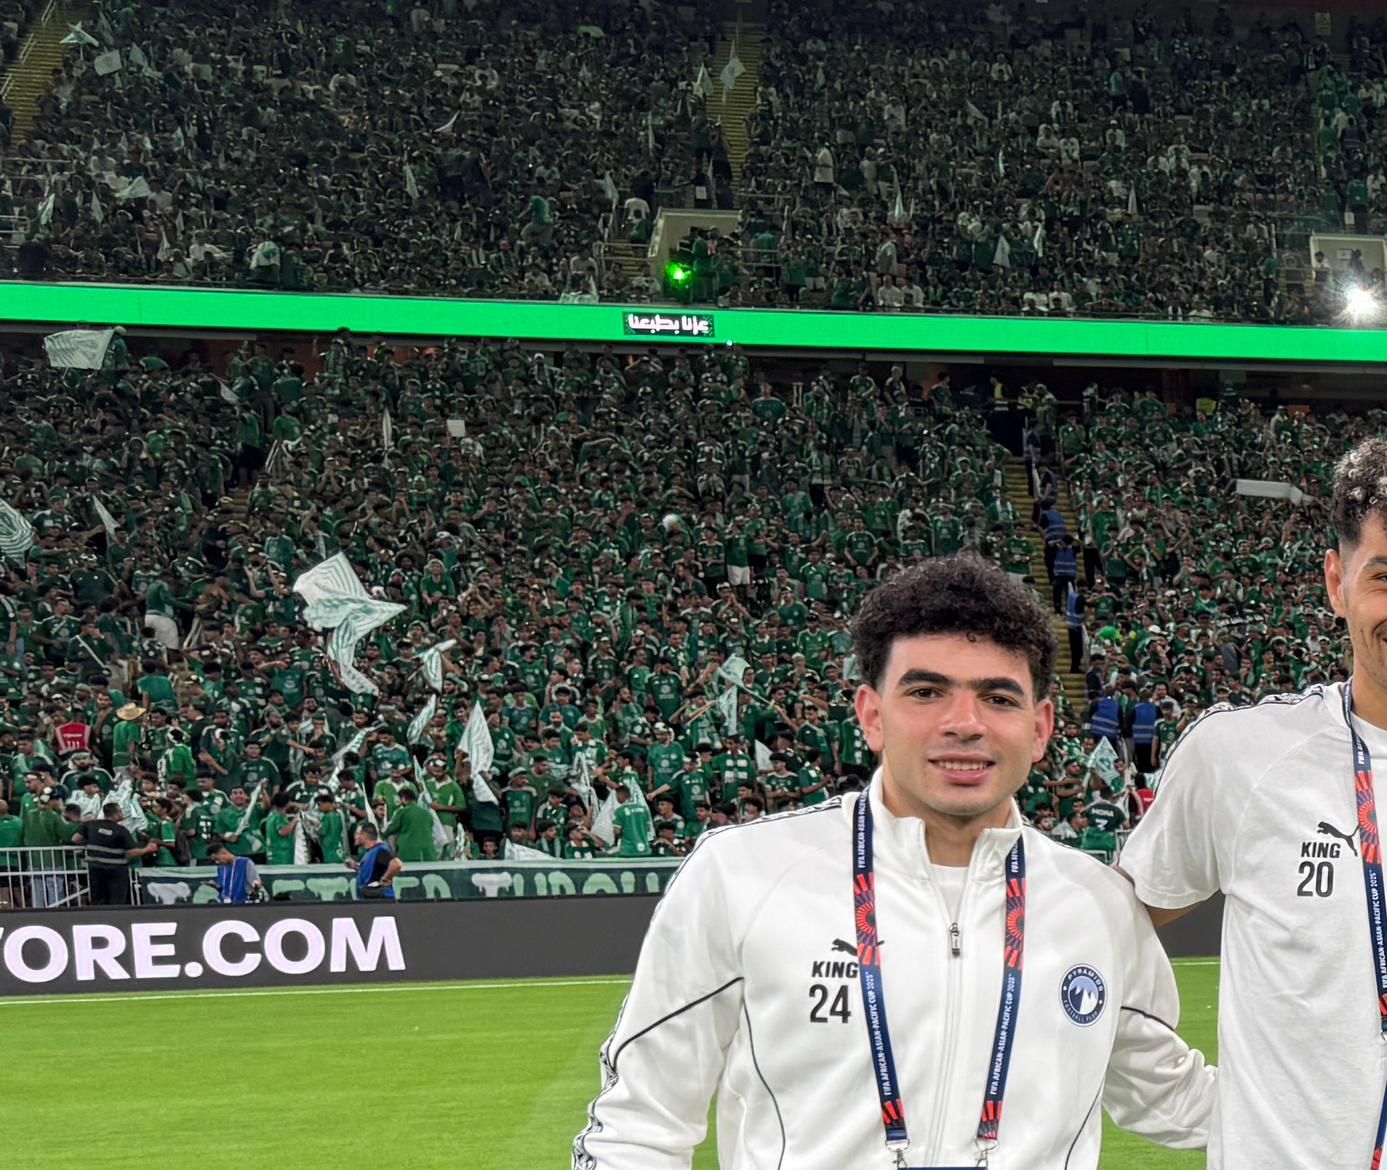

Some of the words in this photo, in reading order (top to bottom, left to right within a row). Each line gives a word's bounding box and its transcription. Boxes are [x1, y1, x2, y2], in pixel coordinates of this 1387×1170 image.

[1301, 842, 1341, 858] KING
[1297, 861, 1334, 898] 20
[0, 916, 406, 983] ORE.COM
[812, 961, 858, 978] KING
[1068, 968, 1104, 992] PYRAMIDS
[809, 984, 852, 1024] 24
